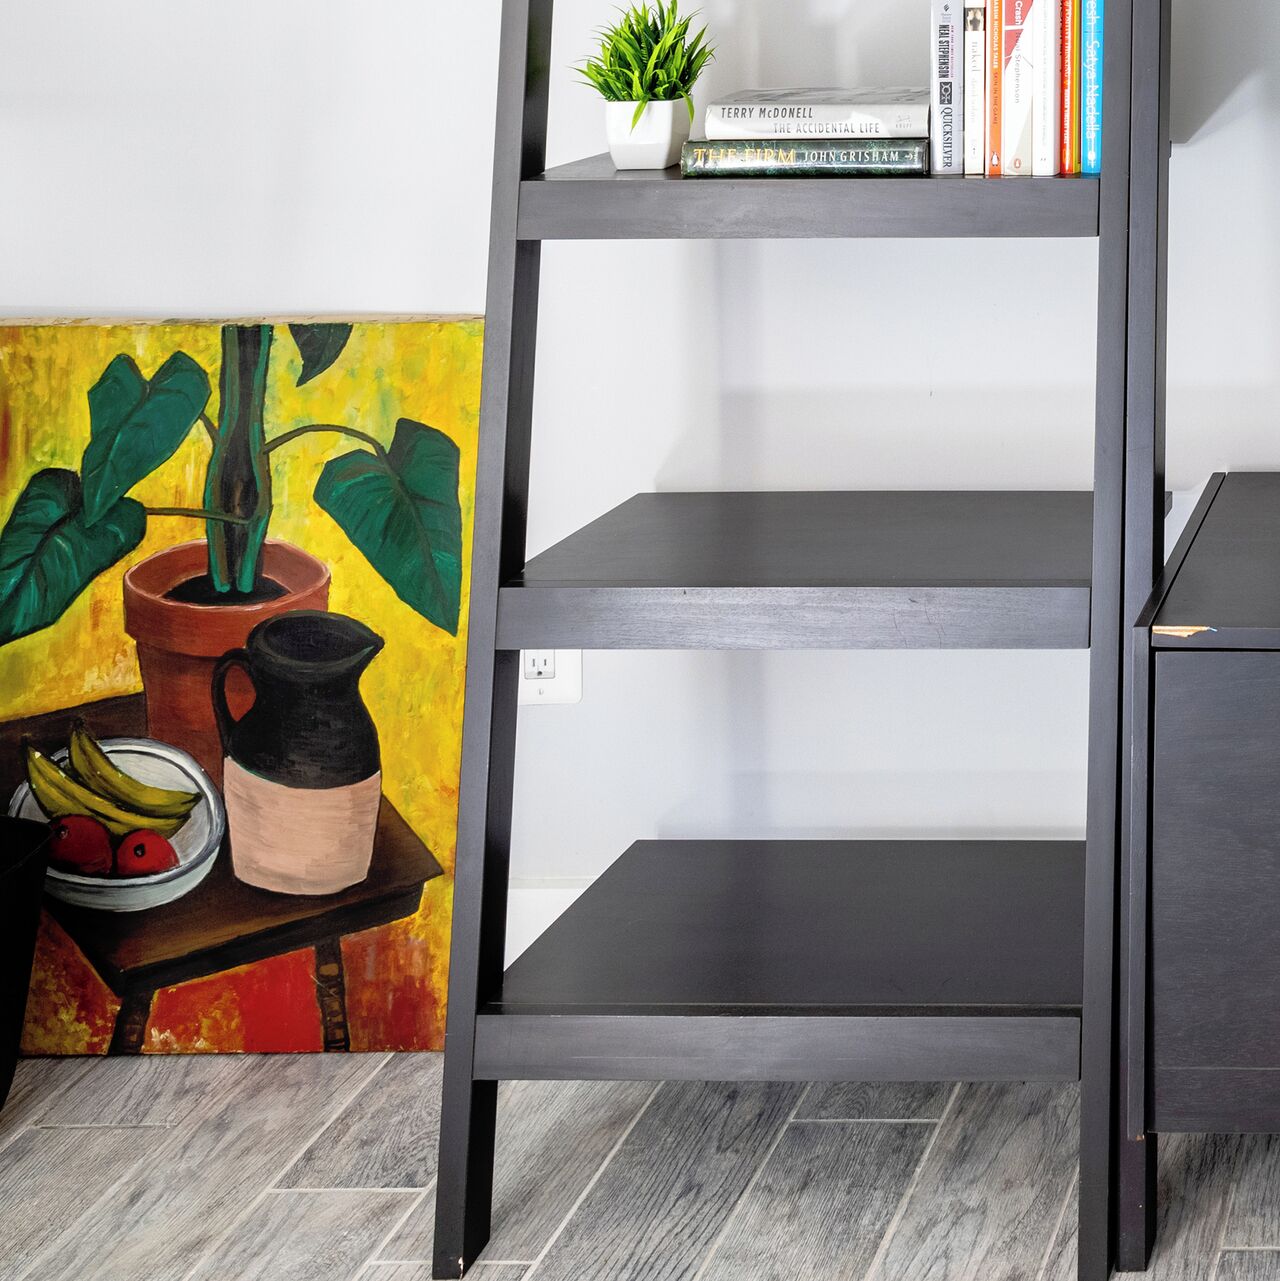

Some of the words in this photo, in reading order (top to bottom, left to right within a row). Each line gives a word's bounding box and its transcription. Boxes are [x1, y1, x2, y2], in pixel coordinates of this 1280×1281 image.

[1015, 0, 1024, 25] Crash
[938, 24, 950, 39] NEAL
[938, 39, 950, 78] STEPHENSON
[1083, 40, 1100, 79] Satya
[721, 107, 754, 119] TERRY
[758, 107, 813, 119] McDONELL
[1085, 84, 1100, 139] Nadella
[774, 122, 792, 133] THE
[796, 122, 855, 134] ACCIDENTAL
[859, 122, 880, 133] LIFE
[941, 107, 953, 168] QUICKSILVER
[693, 148, 736, 167] THE
[744, 148, 797, 164] FIRM
[803, 150, 839, 162] JOHN
[840, 150, 899, 162] GRISHAM
